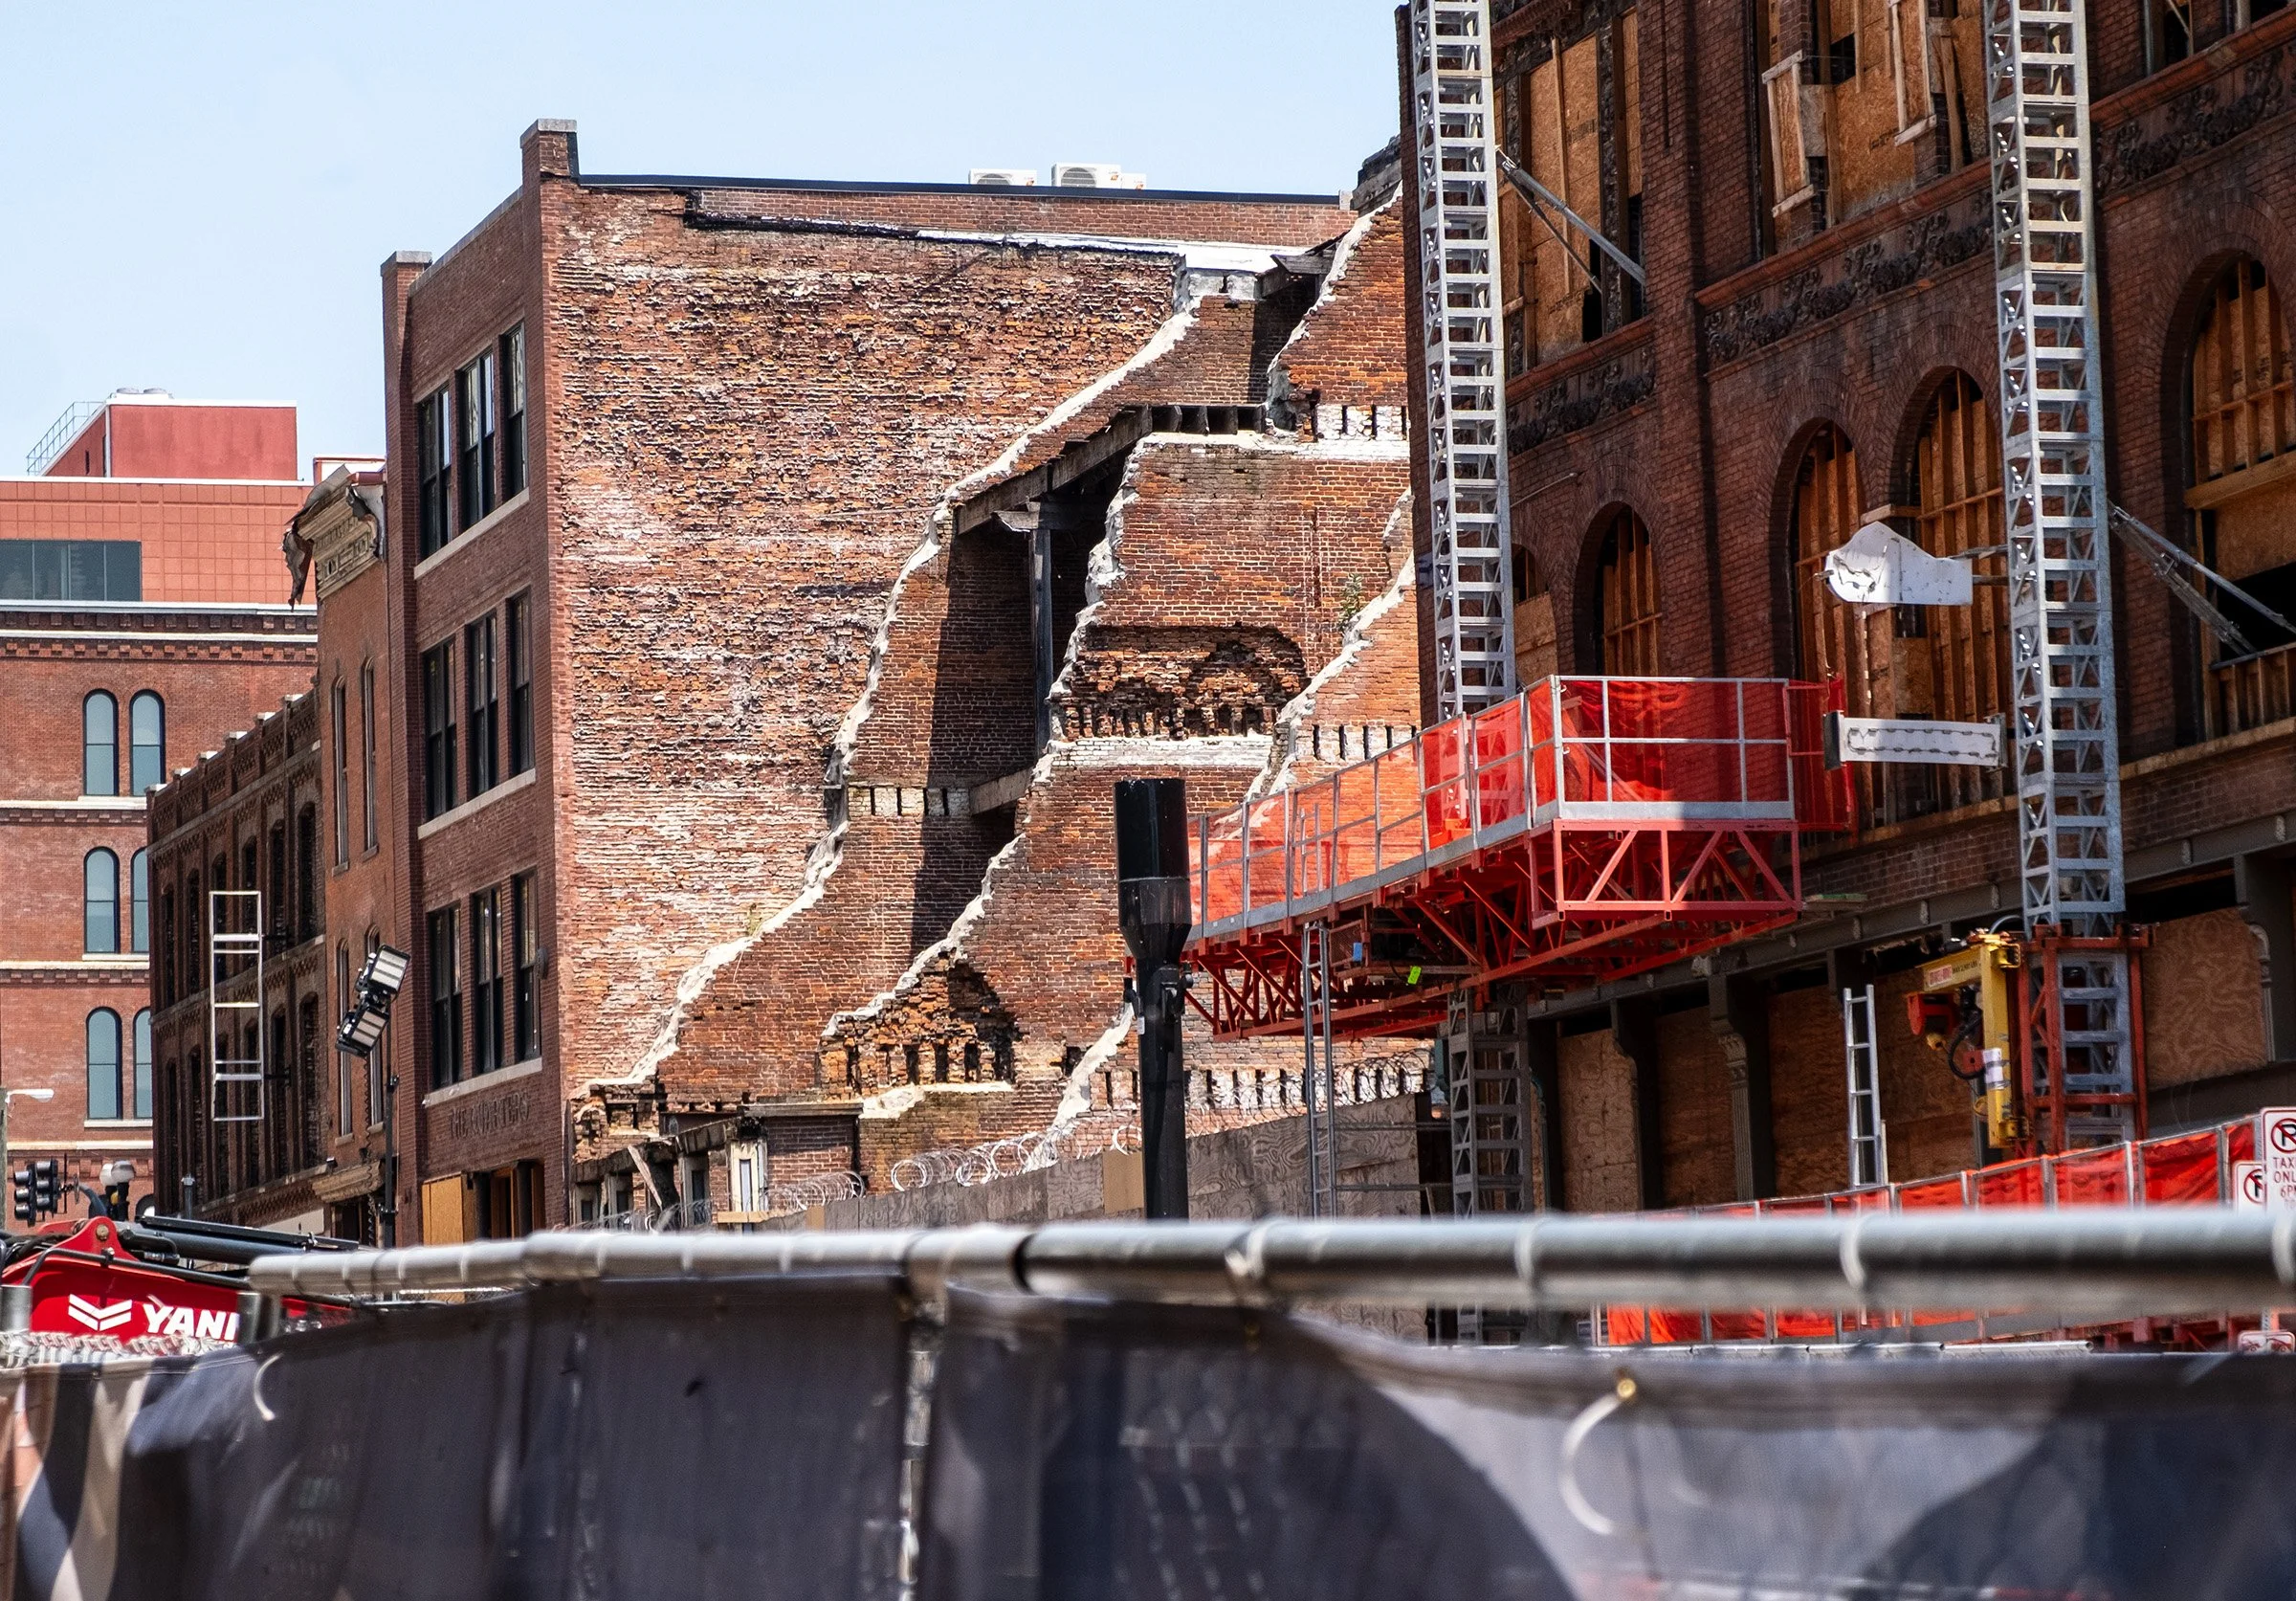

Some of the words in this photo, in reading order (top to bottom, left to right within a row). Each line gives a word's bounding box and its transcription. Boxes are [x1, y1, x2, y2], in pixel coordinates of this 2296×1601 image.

[449, 1107, 469, 1139] THE
[471, 1090, 530, 1135] QUARTERS
[2273, 1157, 2296, 1168] TAX
